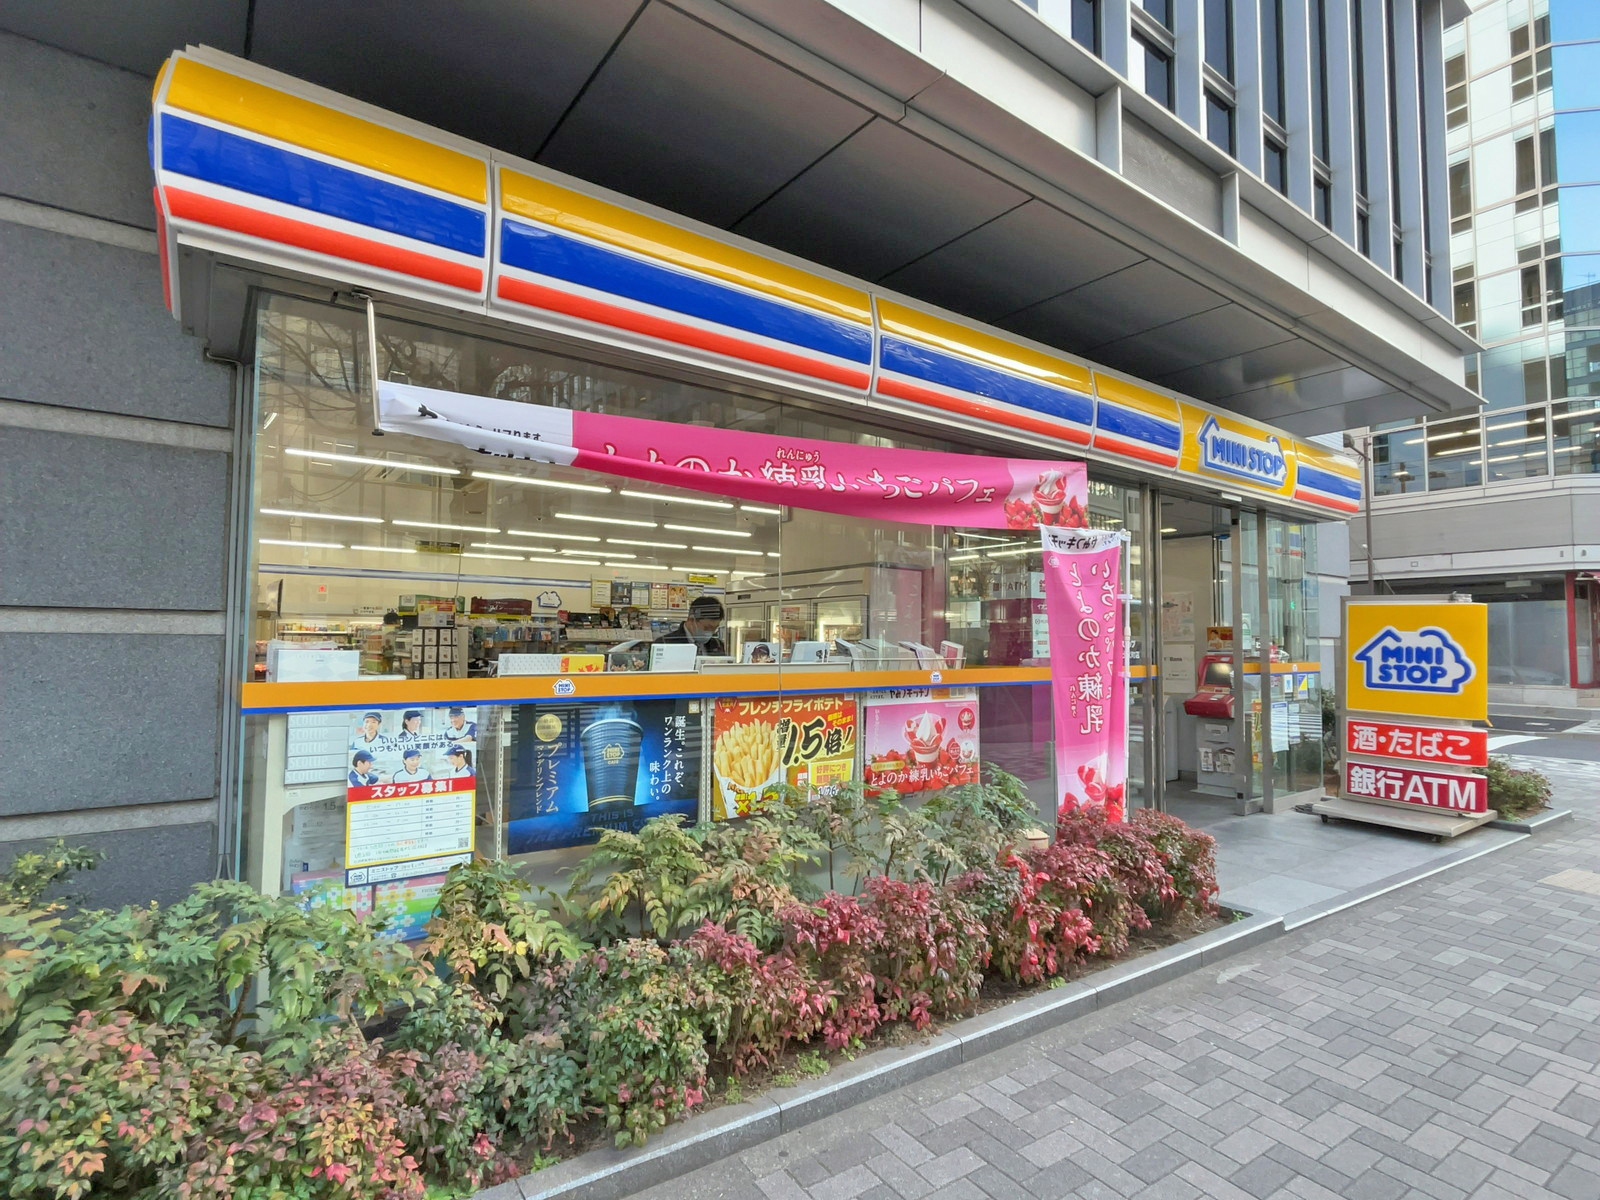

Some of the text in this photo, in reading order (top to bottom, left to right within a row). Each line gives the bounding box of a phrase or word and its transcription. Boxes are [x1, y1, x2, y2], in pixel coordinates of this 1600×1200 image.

[776, 448, 820, 463] れんにゅう
[1212, 435, 1284, 476] MINI STOP
[1381, 645, 1444, 665] MINI
[1378, 664, 1448, 684] STOP
[738, 697, 843, 716] フレンチフライポテト
[661, 716, 673, 795] ワンランク上の
[1352, 724, 1472, 761] 酒・たばこ
[545, 741, 563, 813] プレミアム
[649, 760, 661, 800] 味わい。
[1350, 765, 1477, 811] 銀行ATM
[590, 810, 620, 823] THIS
[623, 808, 634, 819] IS
